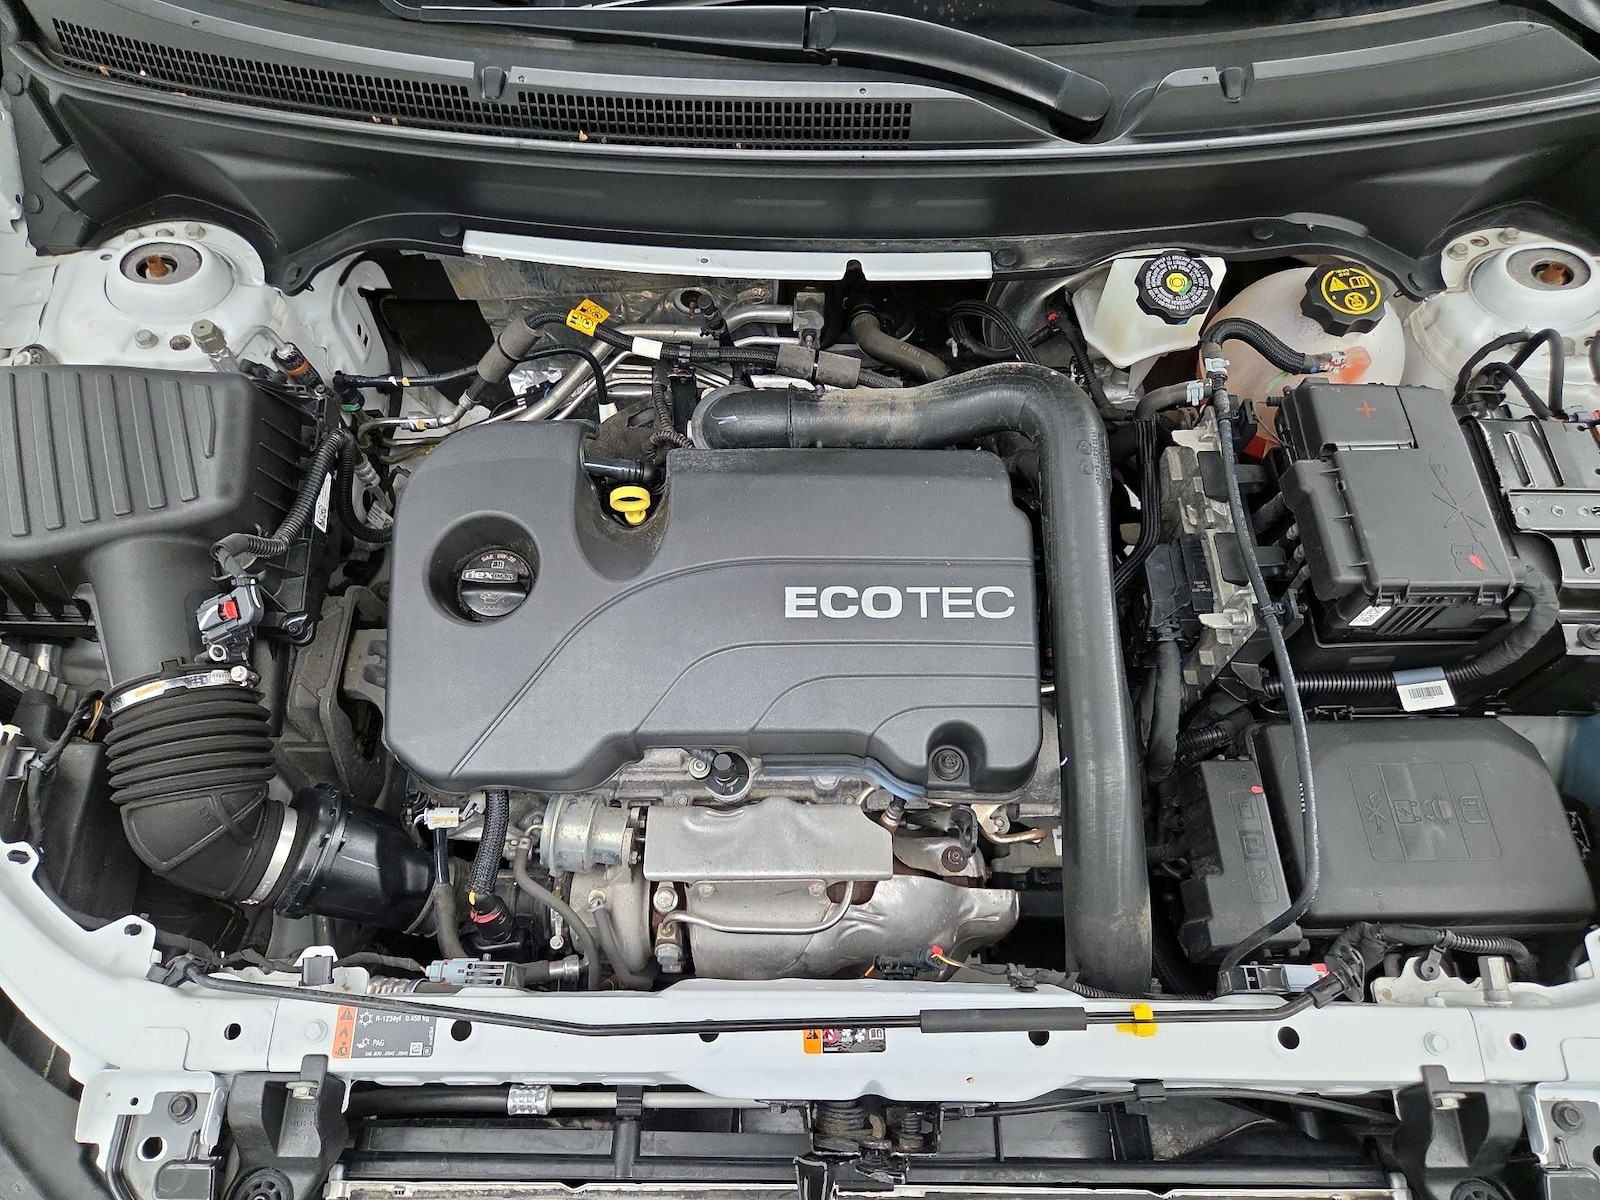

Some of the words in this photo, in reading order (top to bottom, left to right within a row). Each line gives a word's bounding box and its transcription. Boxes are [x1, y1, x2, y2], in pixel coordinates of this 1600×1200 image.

[481, 554, 494, 562] SAE
[784, 585, 1016, 619] ECOTEC
[372, 1039, 385, 1047] PAG
